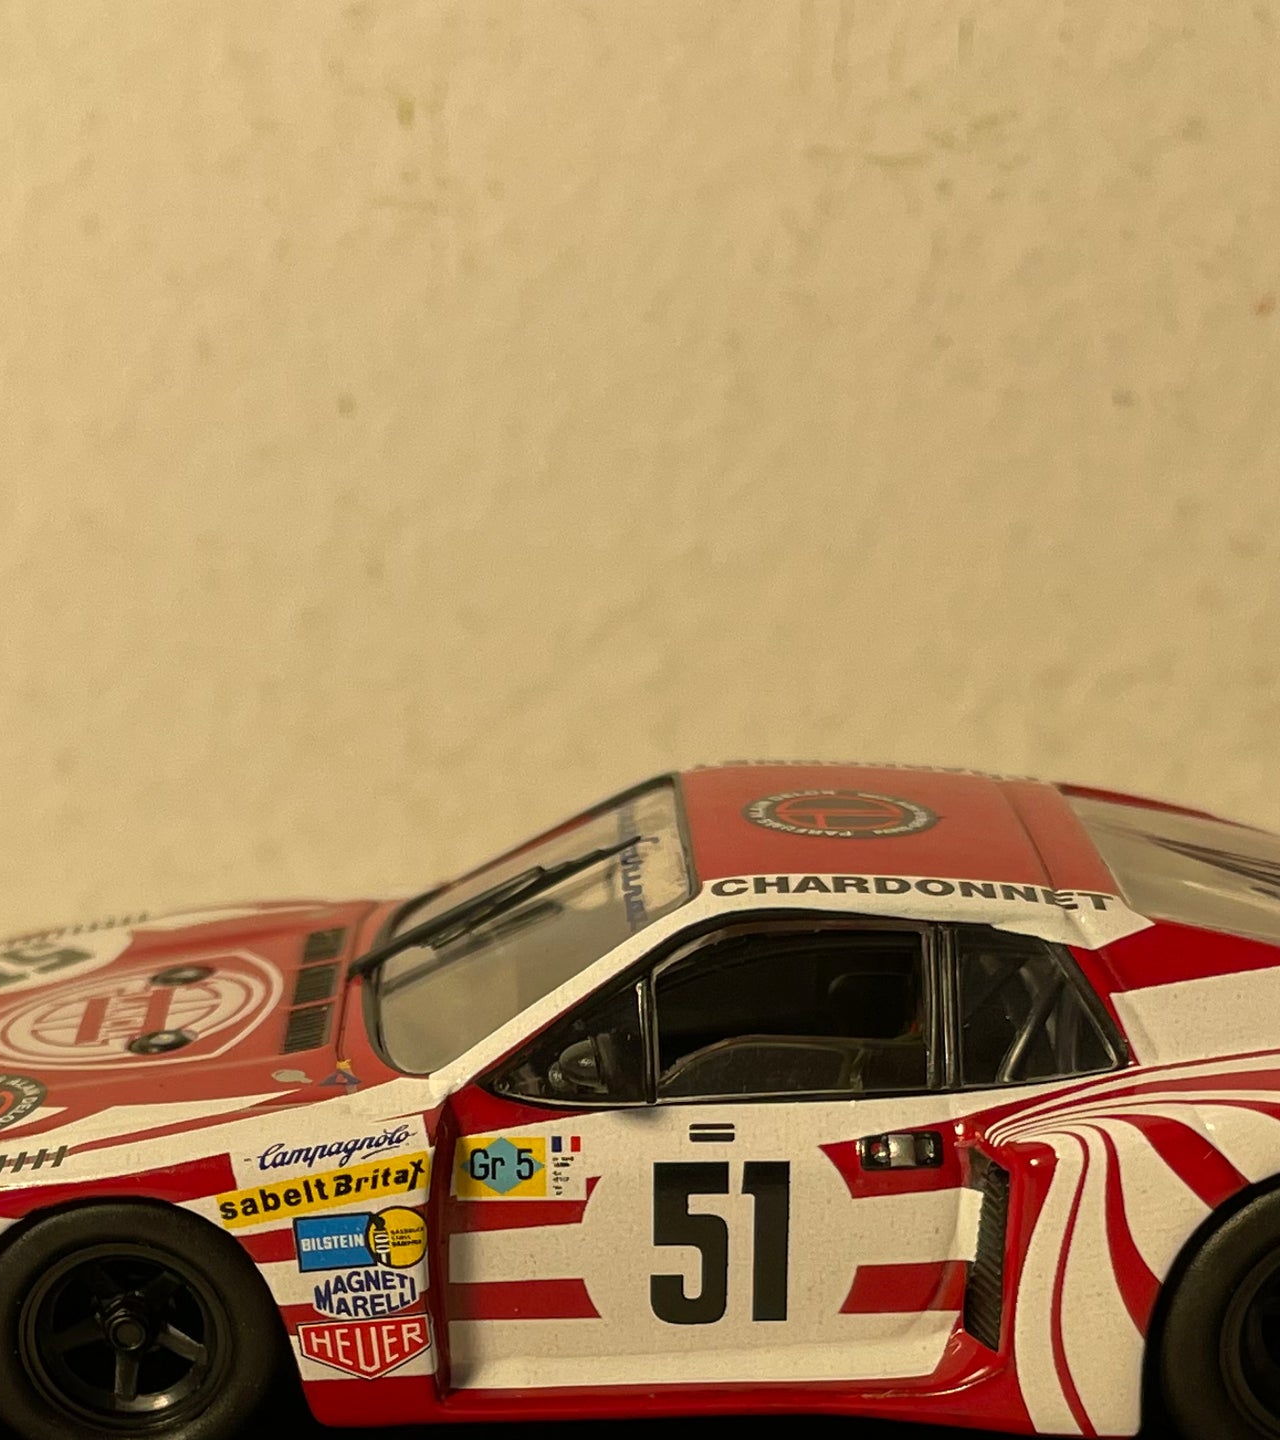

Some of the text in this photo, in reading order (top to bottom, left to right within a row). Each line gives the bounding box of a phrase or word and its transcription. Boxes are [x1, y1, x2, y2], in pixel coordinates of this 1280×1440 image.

[711, 876, 1116, 911] CHARDONNET
[257, 1125, 417, 1170] Campagnolo
[470, 1148, 505, 1180] Gr
[516, 1148, 534, 1180] 5
[220, 1179, 329, 1220] sabelt
[301, 1233, 365, 1252] BILSTEIN
[650, 1161, 790, 1325] 51
[314, 1270, 417, 1302] MAGNETI
[310, 1322, 424, 1373] HEUER
